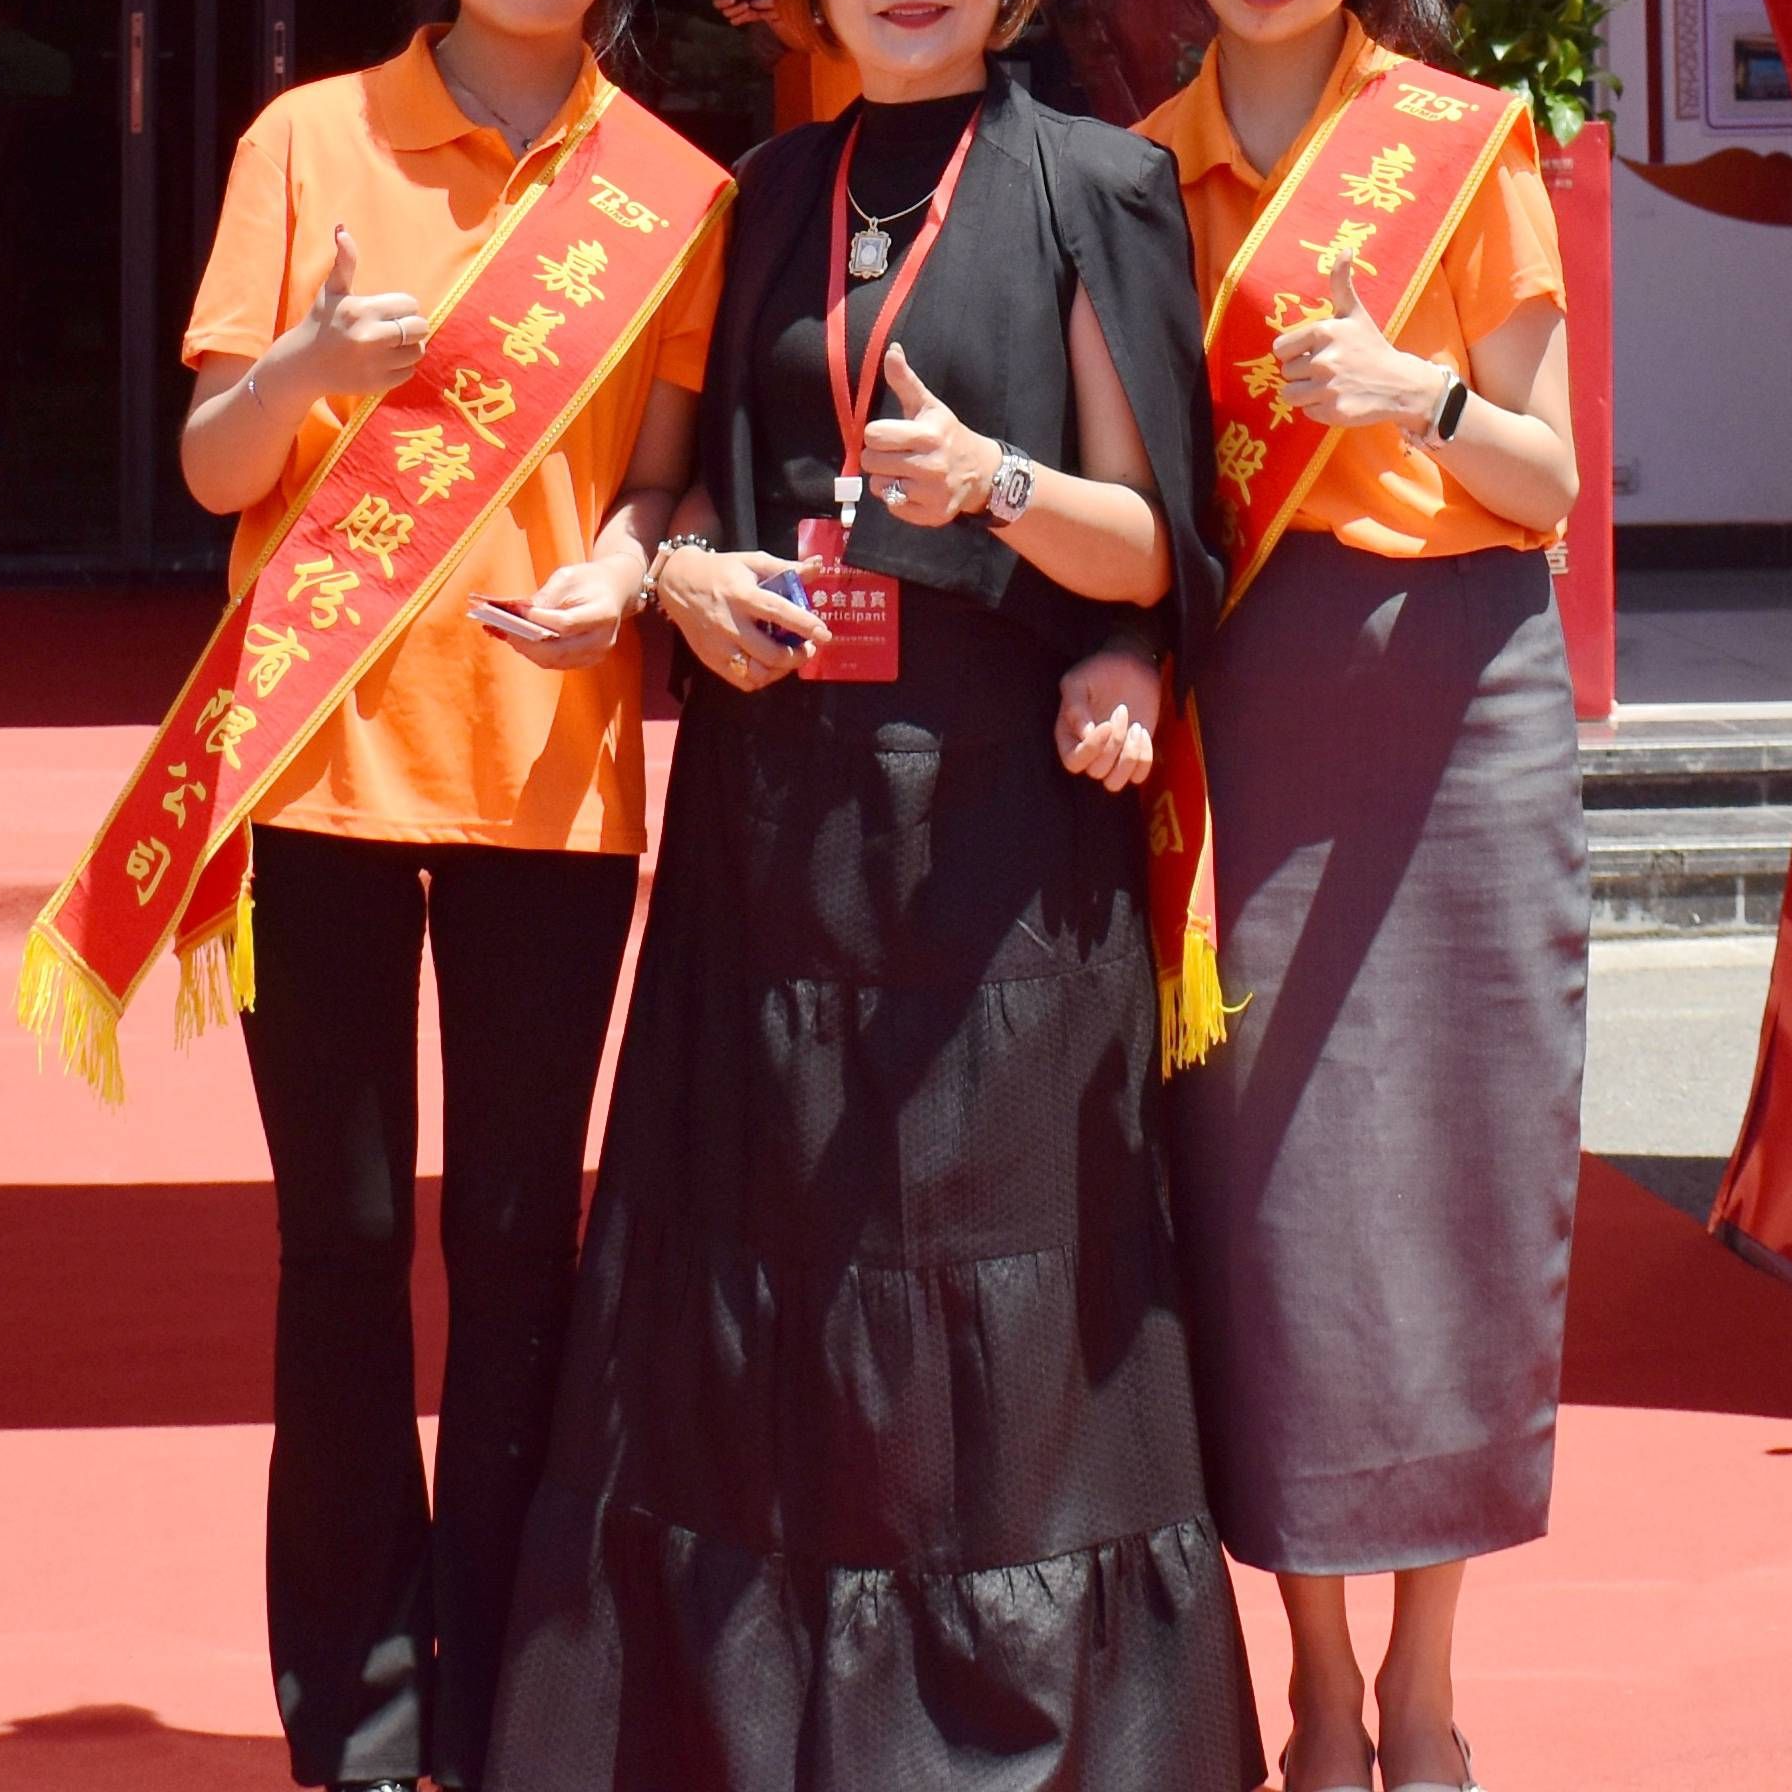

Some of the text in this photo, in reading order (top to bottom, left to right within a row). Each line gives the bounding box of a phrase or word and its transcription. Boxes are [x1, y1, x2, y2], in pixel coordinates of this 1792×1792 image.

[125, 238, 607, 907] 嘉善边锋股份有限公司
